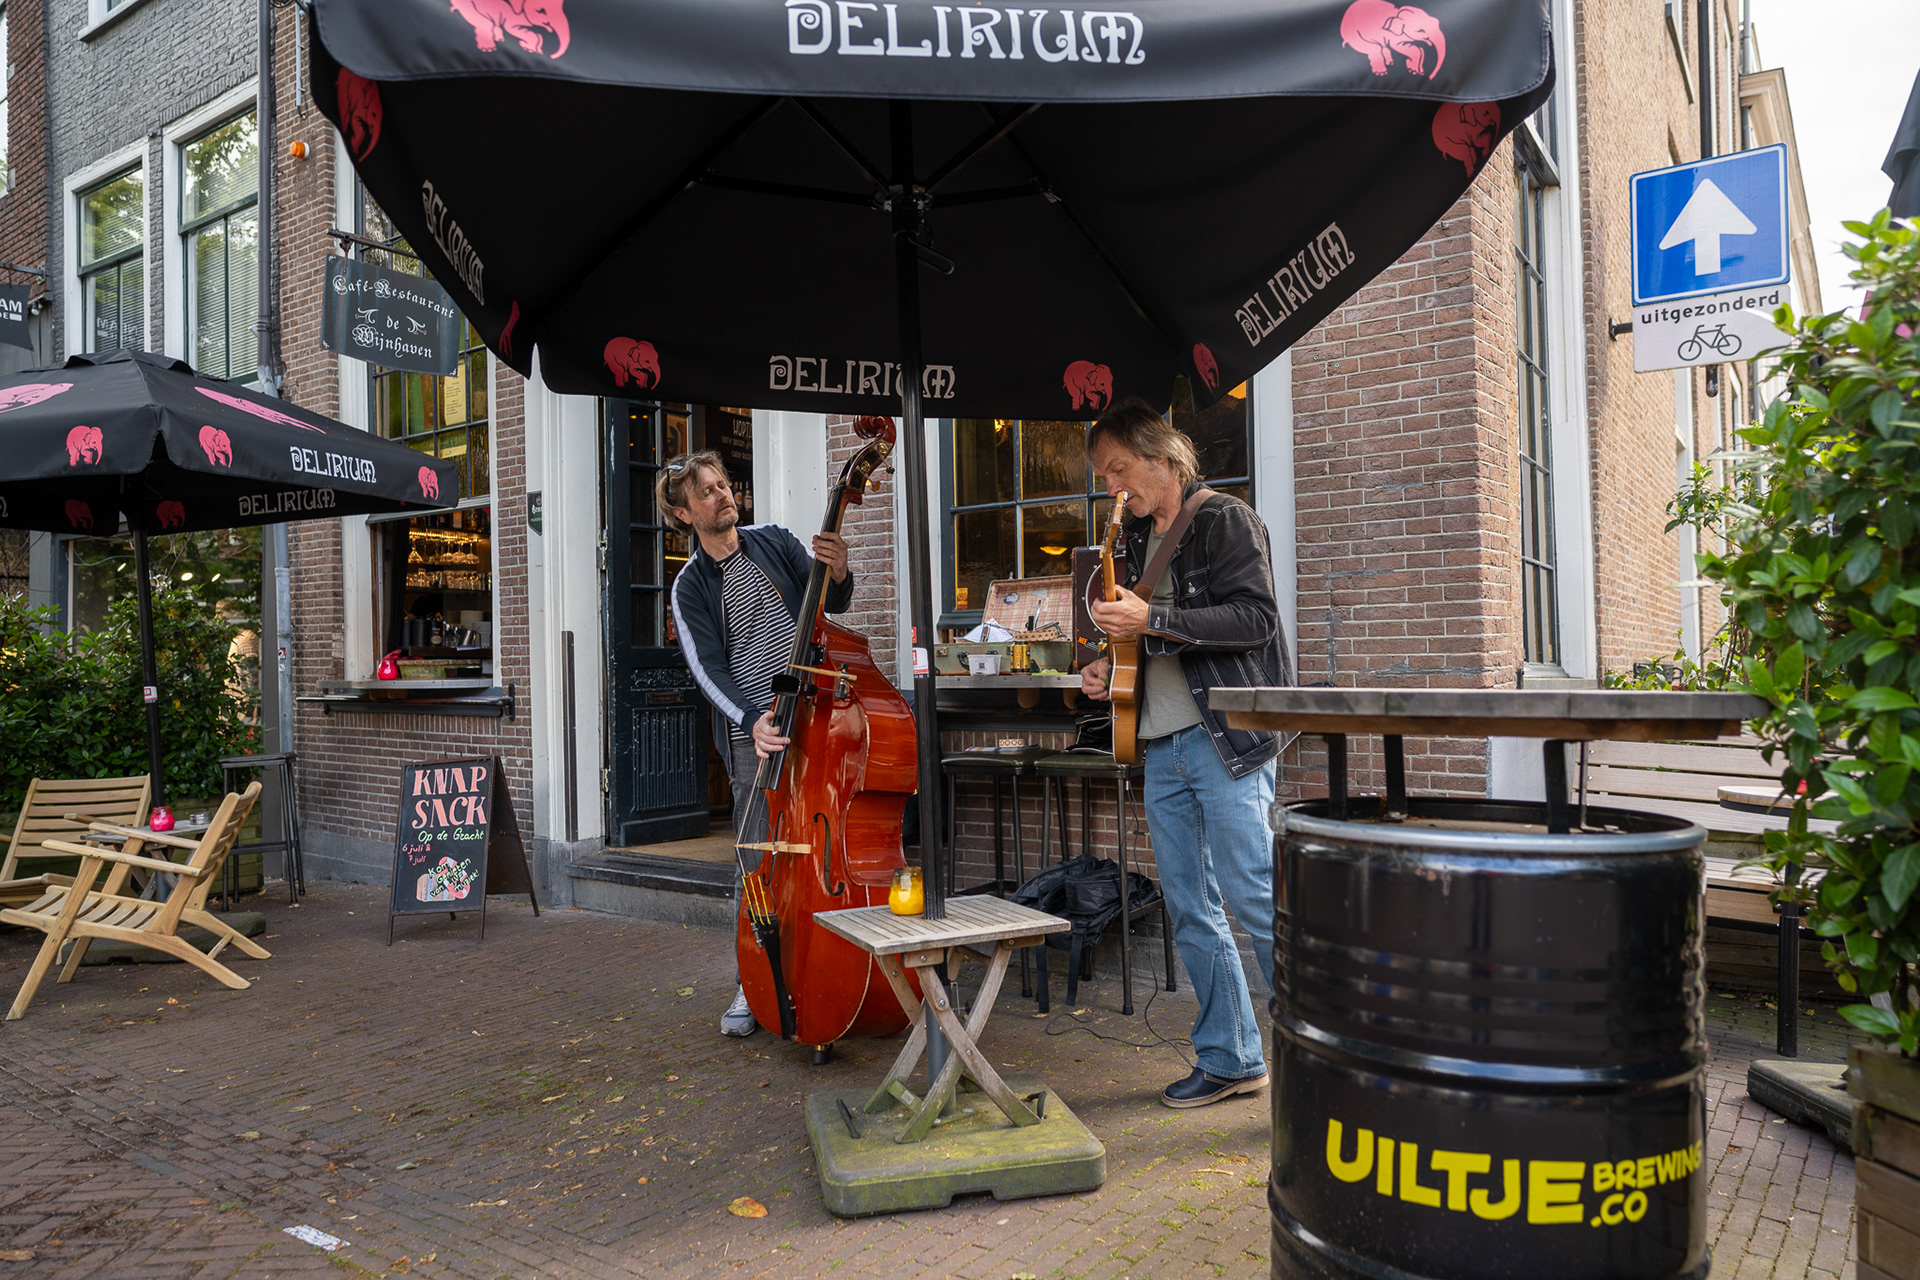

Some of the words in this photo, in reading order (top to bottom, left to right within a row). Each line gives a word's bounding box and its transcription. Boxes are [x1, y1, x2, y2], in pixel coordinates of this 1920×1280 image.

[785, 0, 1146, 65] DELIRIUM
[422, 179, 485, 306] DELIRIUM
[332, 274, 455, 319] Café-Restaurant
[1234, 221, 1355, 347] DELIRIUM
[386, 315, 400, 330] de
[1641, 290, 1780, 324] uitgezonderd
[352, 323, 432, 359] Wijnhaven
[290, 445, 377, 483] DELIRIUM
[238, 488, 336, 516] DELIRIUM
[412, 766, 487, 796] KNAP
[411, 796, 487, 829] SACK
[408, 844, 424, 854] juli
[418, 830, 433, 844] Op
[437, 830, 448, 840] de
[453, 827, 484, 841] Gracht
[412, 855, 426, 866] juli
[430, 886, 444, 897] van
[1326, 1118, 1586, 1224] UILTJE
[1593, 1138, 1702, 1193] BREWING
[1590, 1190, 1648, 1228] .CO
